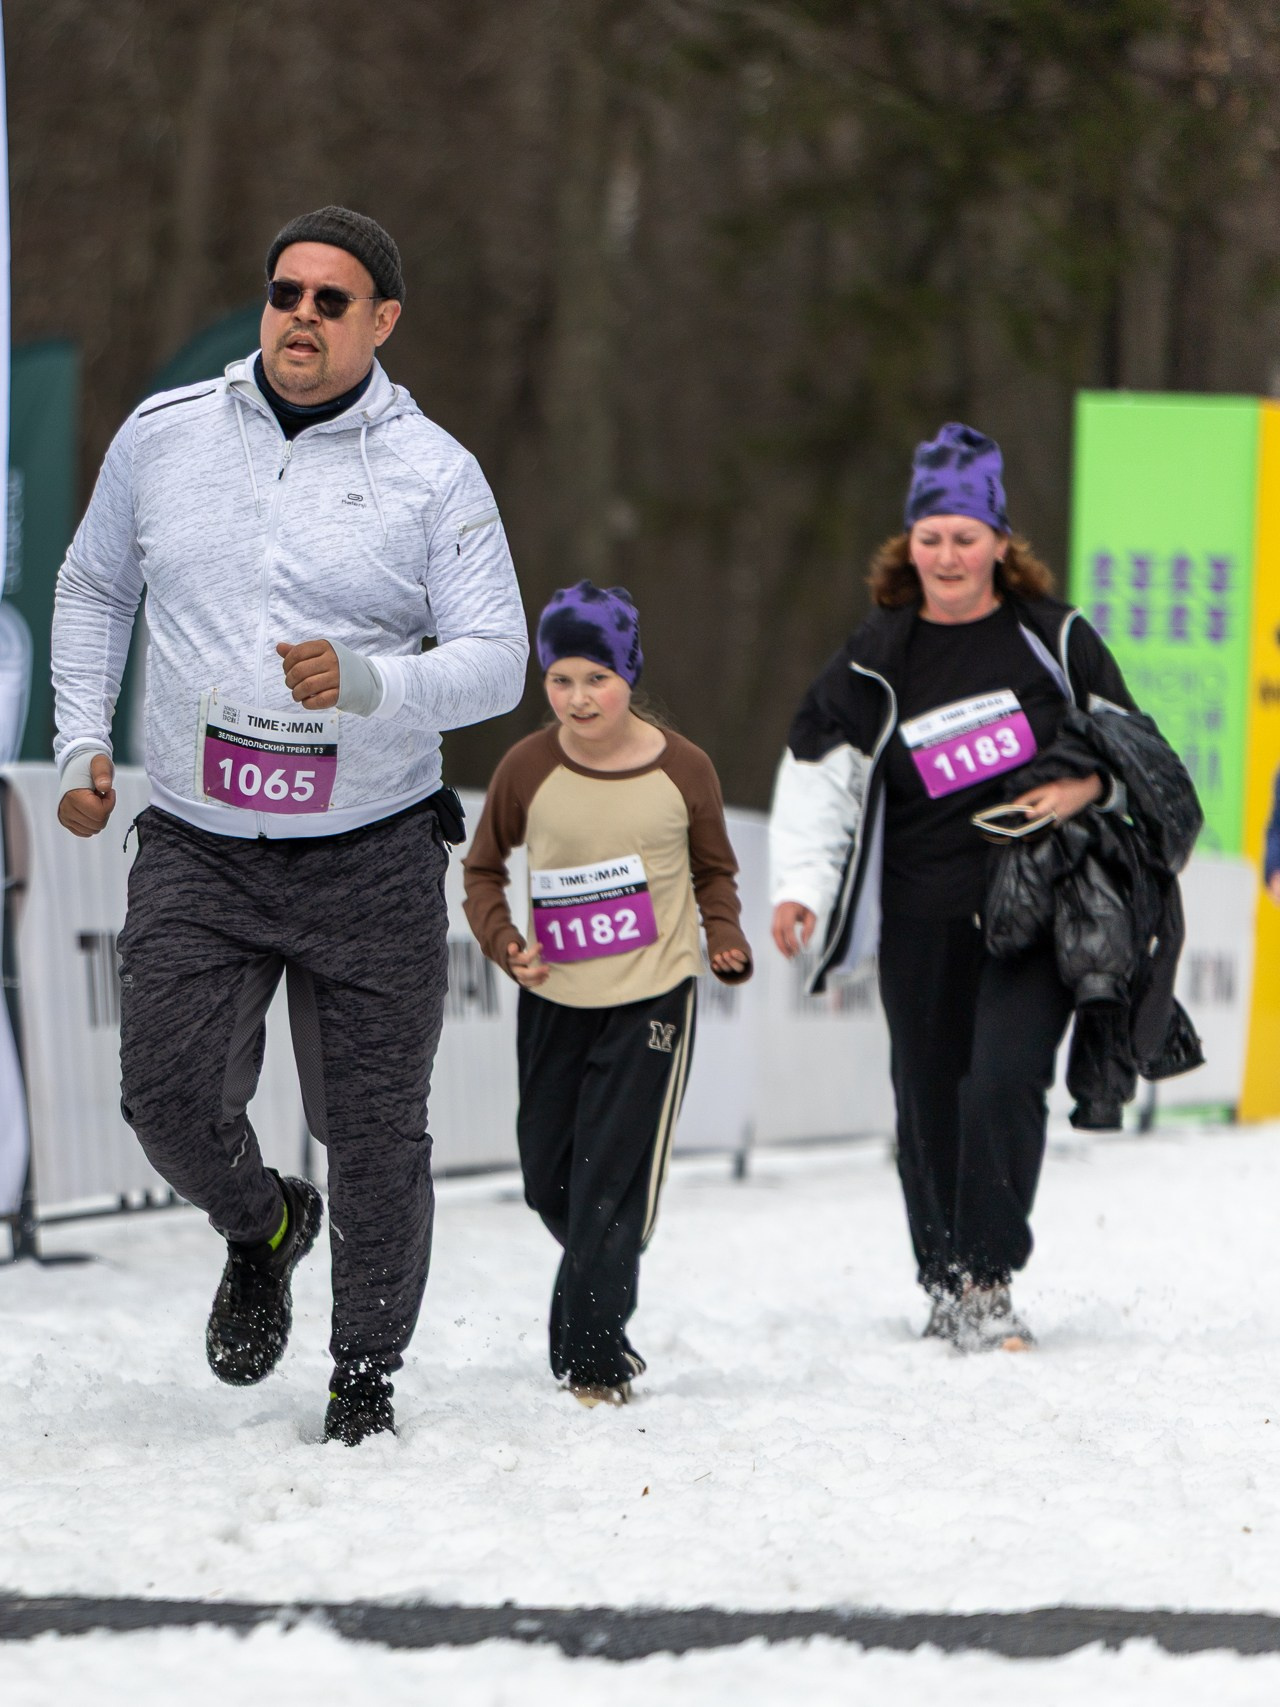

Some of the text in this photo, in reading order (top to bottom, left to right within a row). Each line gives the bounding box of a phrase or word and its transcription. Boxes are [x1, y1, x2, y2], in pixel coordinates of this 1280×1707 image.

[217, 731, 285, 753] ЗЕЛЕНОДОЛЬСКИЙ
[286, 745, 311, 754] ТРЕЙЛ
[933, 727, 1021, 781] 1183
[218, 758, 316, 802] 1065
[547, 908, 641, 951] 1182
